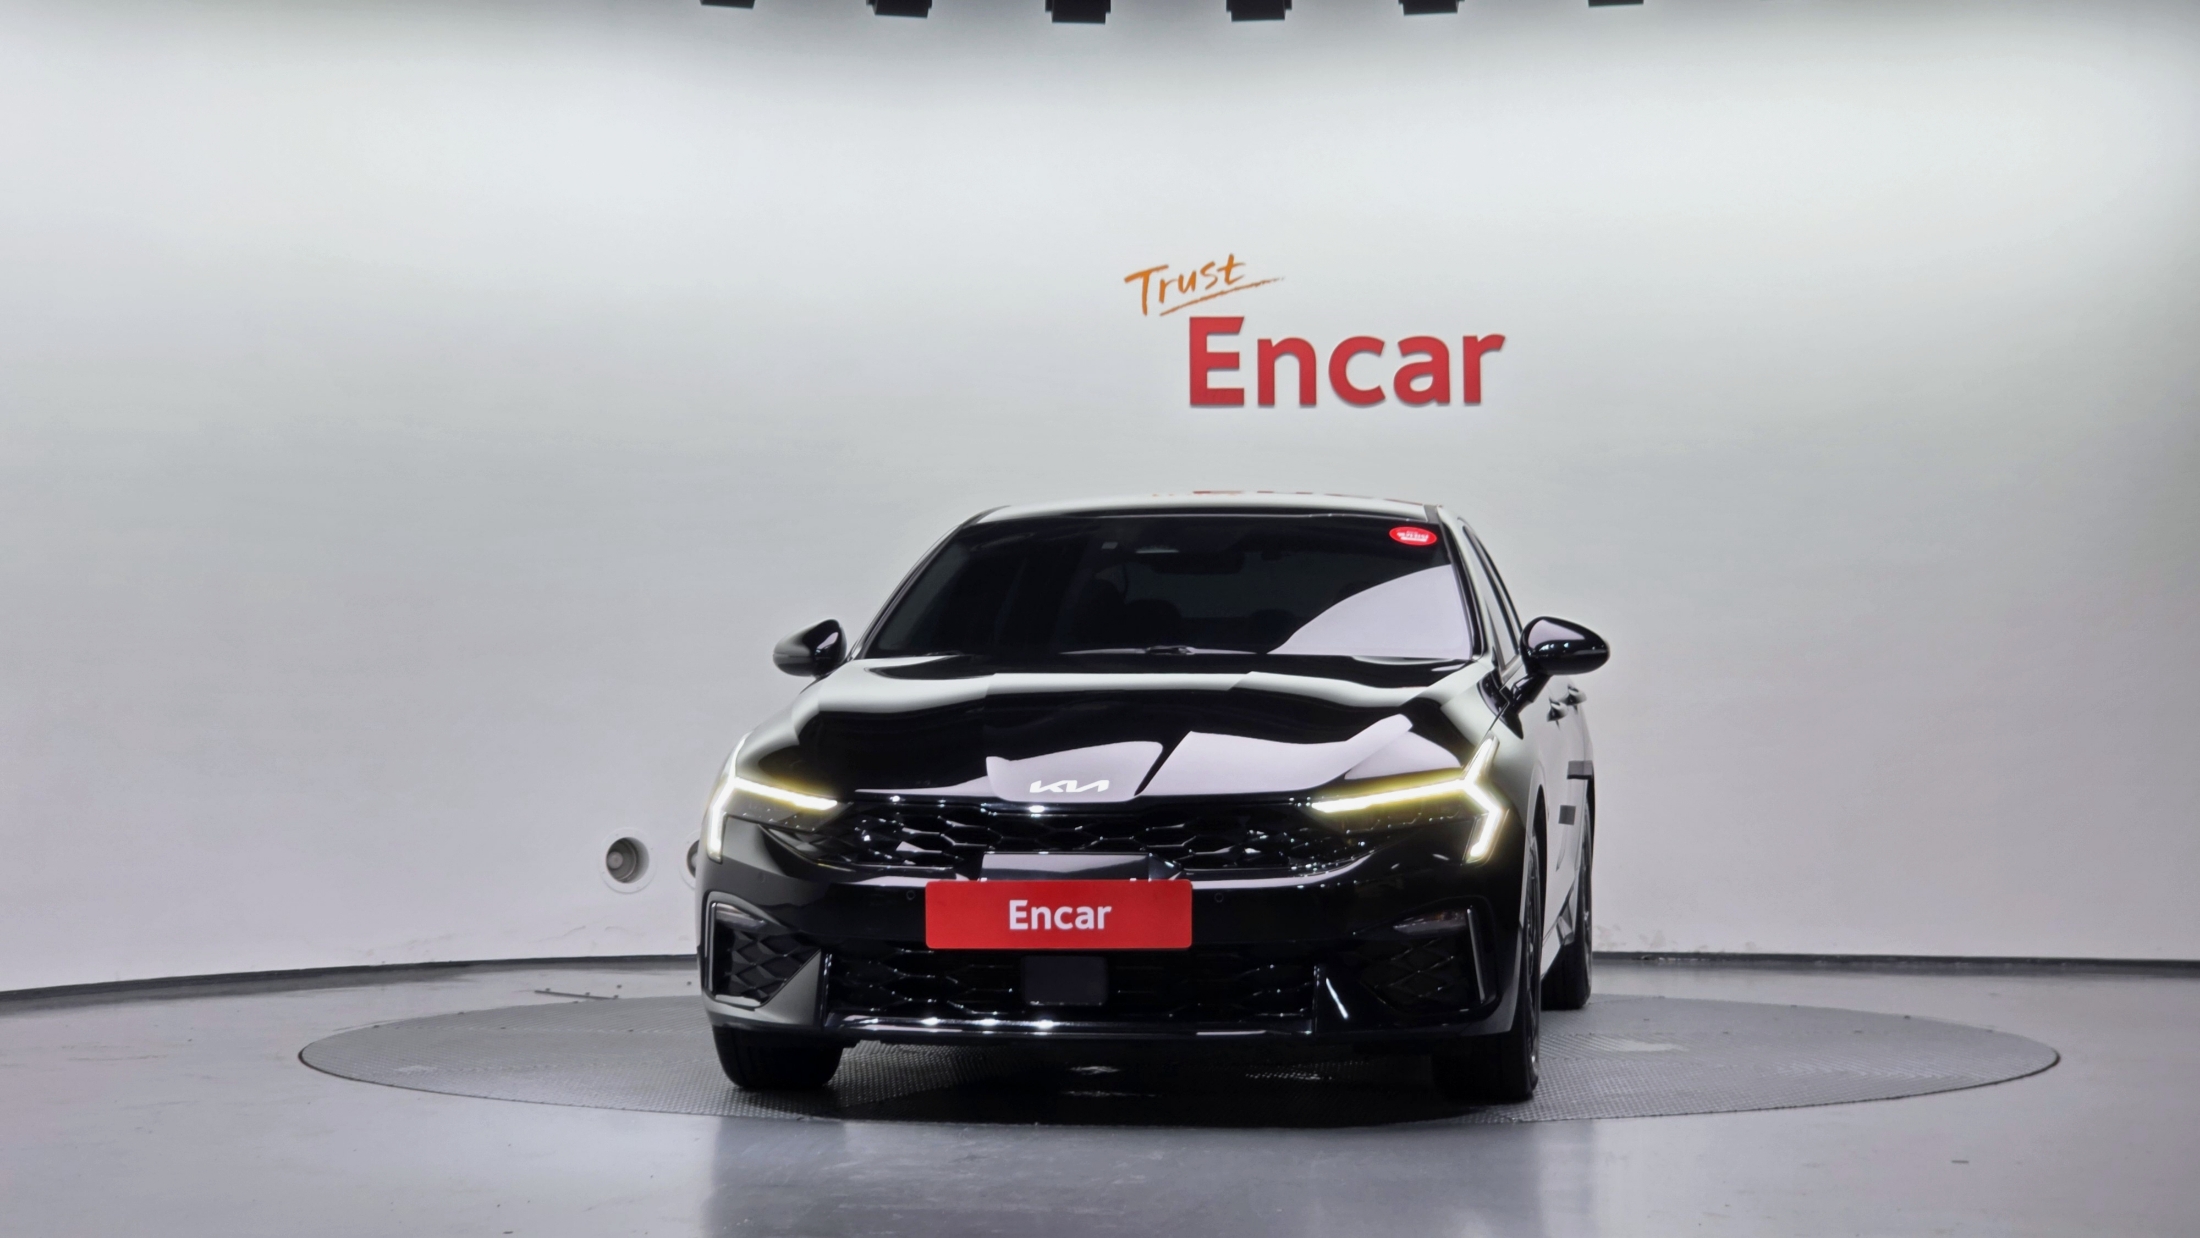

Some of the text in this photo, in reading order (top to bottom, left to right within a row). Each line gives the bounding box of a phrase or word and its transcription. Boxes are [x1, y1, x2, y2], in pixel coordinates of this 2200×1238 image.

[1124, 253, 1247, 316] Trust
[1189, 316, 1506, 407] Encar
[1009, 899, 1112, 930] Encar
